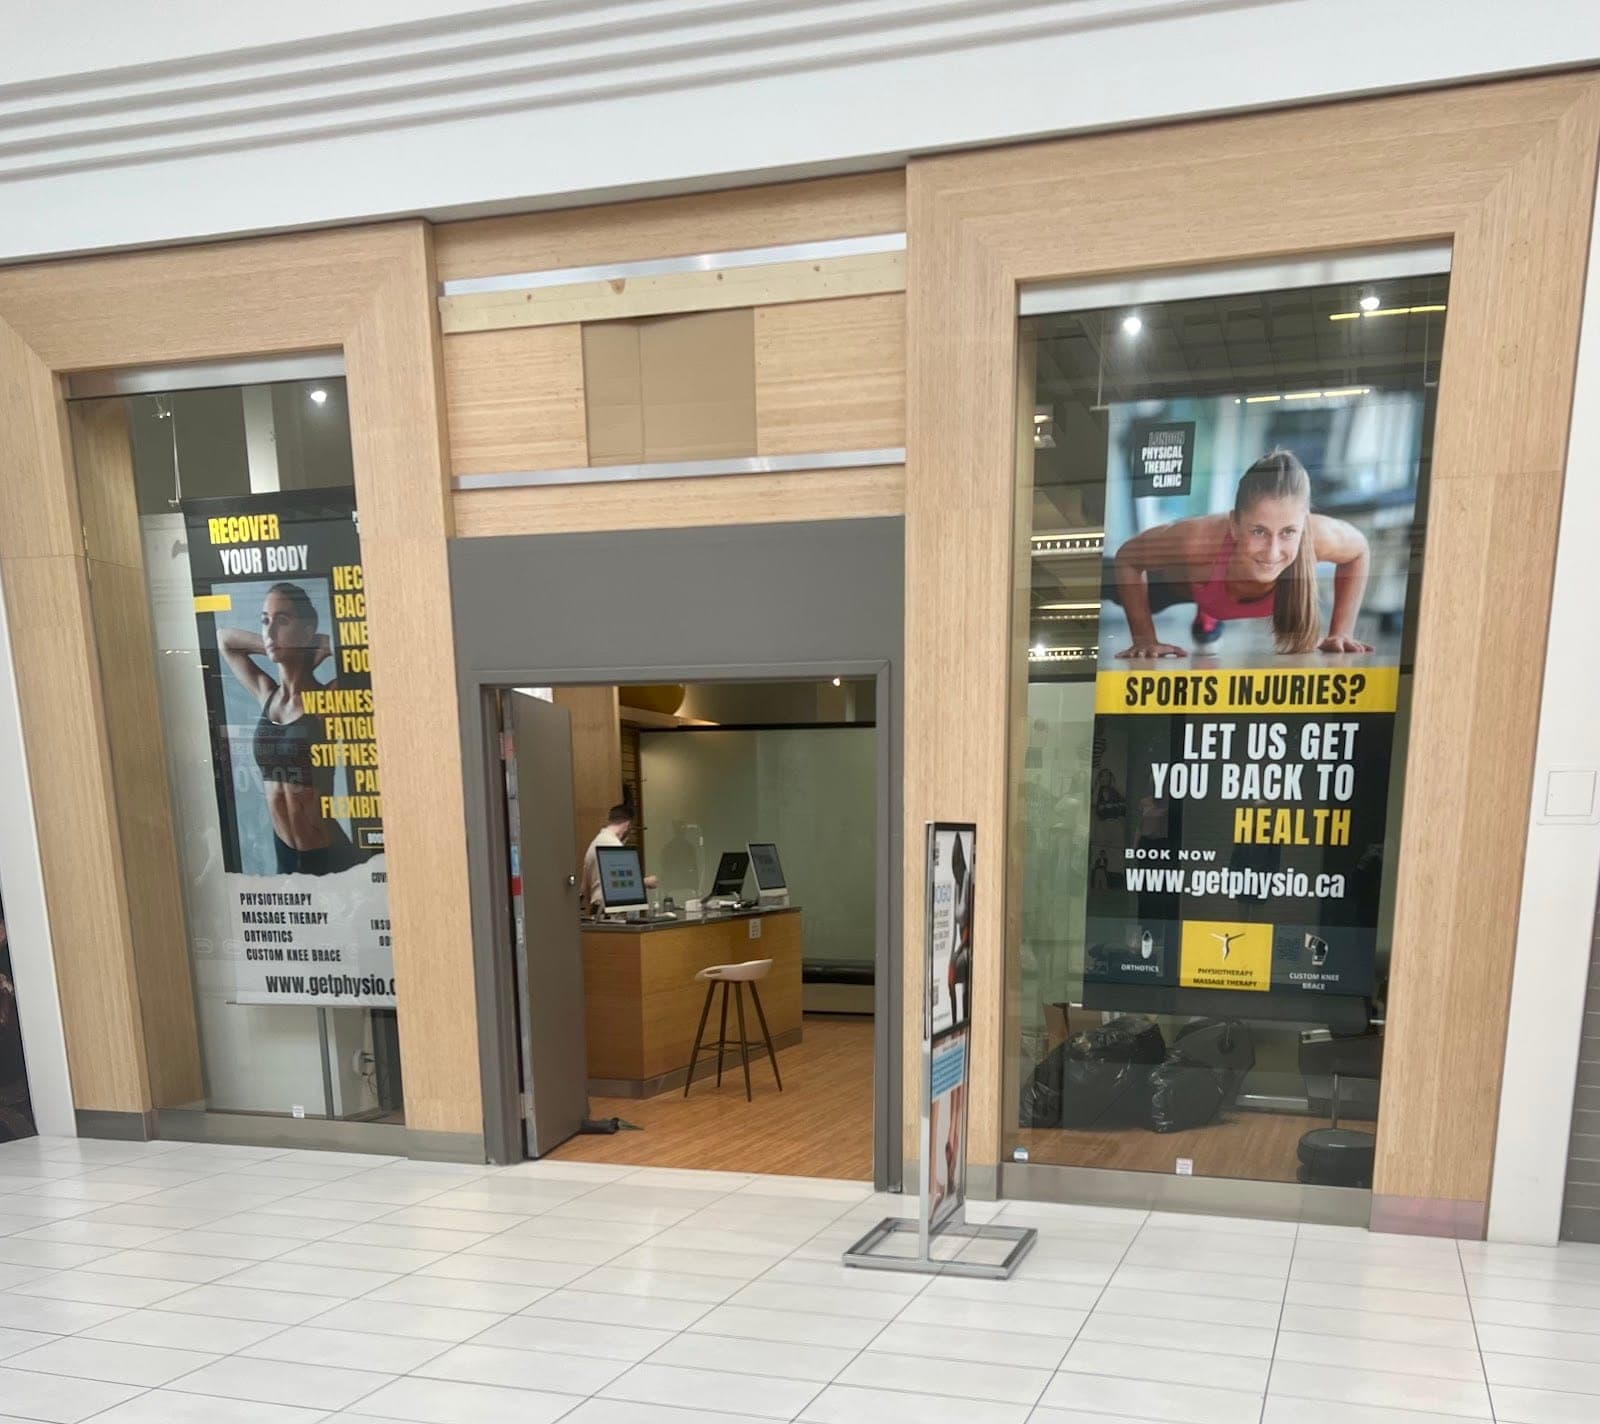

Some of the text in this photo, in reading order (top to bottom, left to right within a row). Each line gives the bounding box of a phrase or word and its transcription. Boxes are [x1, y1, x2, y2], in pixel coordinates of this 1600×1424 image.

[1142, 445, 1183, 461] PHYSICAL
[1144, 460, 1183, 475] THERAPY
[1153, 474, 1182, 488] CLINIC
[208, 513, 280, 545] RECOVER
[219, 545, 308, 575] YOUR BODY
[1125, 673, 1366, 706] SPORTS INJURIES?
[1184, 722, 1360, 761] LET US GET
[1151, 763, 1355, 801] YOU BACK TO
[1234, 808, 1351, 846] HEALTH
[1125, 848, 1216, 861] BOOK NOW
[1125, 867, 1345, 899] www.getphysio.ca
[240, 893, 311, 906] PHYSIOTHERAPY
[242, 911, 328, 925] MASSAGE THERAPY
[244, 930, 293, 943] ORTHOTICS
[246, 948, 342, 962] CUSTOM KNEE BRACE
[1120, 963, 1160, 973] ORTHOTICS
[1197, 967, 1254, 977] PHYSIOTHERAPY
[1193, 978, 1258, 987] MASSAGE THERAPY
[1289, 972, 1319, 980] CUSTOM
[1302, 982, 1326, 991] BRACE
